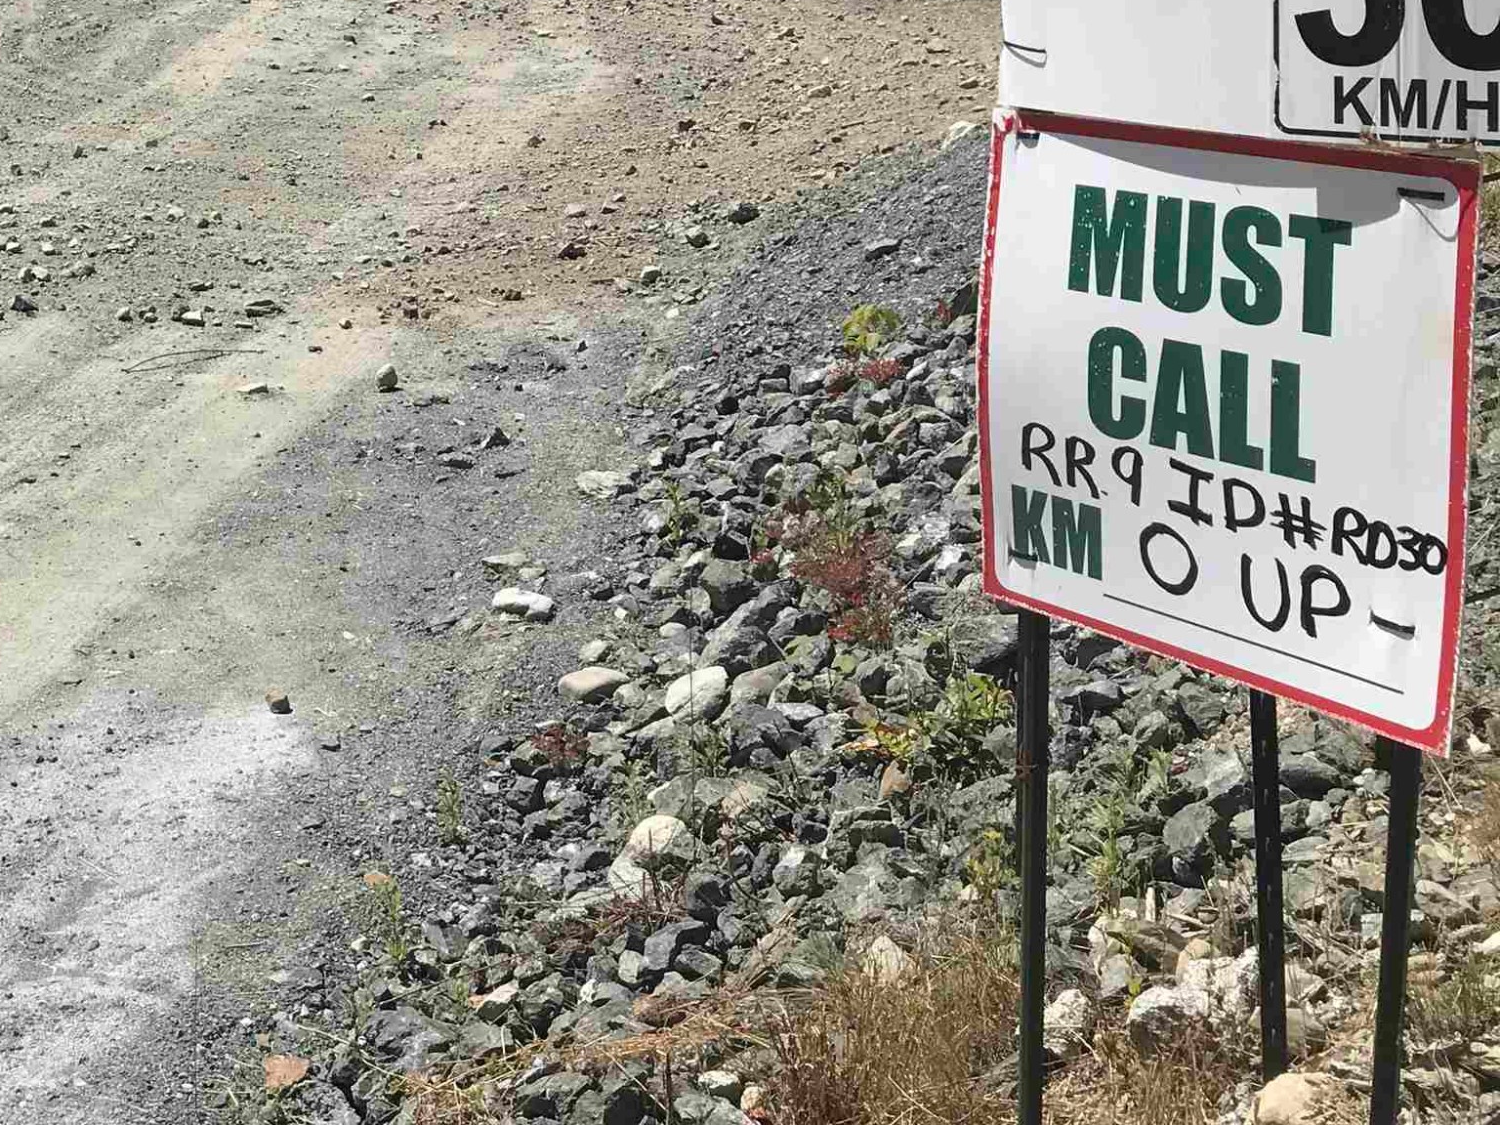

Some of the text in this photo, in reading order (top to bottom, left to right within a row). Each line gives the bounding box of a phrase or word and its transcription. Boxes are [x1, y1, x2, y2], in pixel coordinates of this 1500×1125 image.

[1333, 75, 1500, 133] KM/H
[1067, 183, 1353, 338] MUST
[1086, 326, 1316, 484] CALL
[1011, 483, 1103, 581] KM
[1240, 552, 1352, 639] UP
